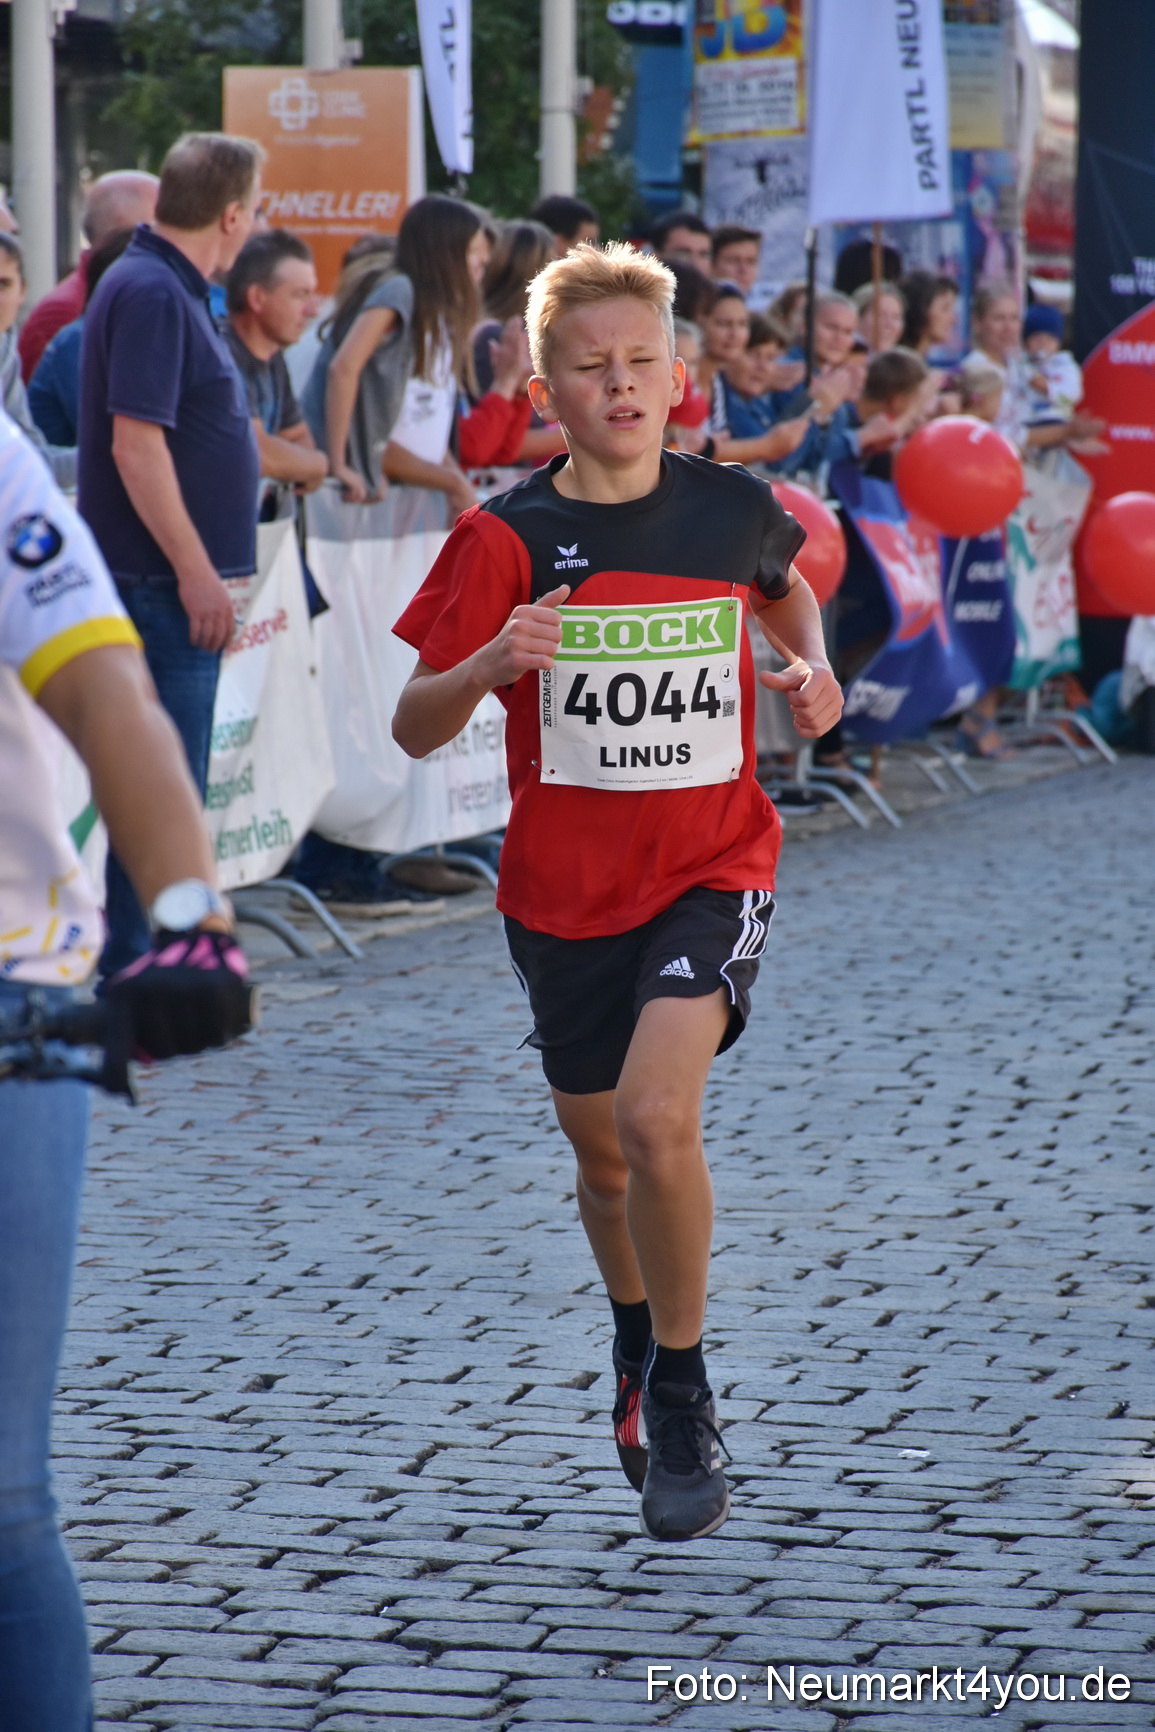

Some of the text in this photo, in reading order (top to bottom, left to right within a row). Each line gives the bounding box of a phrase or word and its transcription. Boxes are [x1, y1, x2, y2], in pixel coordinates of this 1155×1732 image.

[905, 76, 939, 191] PARTL
[554, 558, 589, 570] erima
[561, 608, 720, 653] BOCK
[563, 667, 721, 727] 4044
[600, 743, 691, 768] LINUS
[659, 967, 695, 980] adidas
